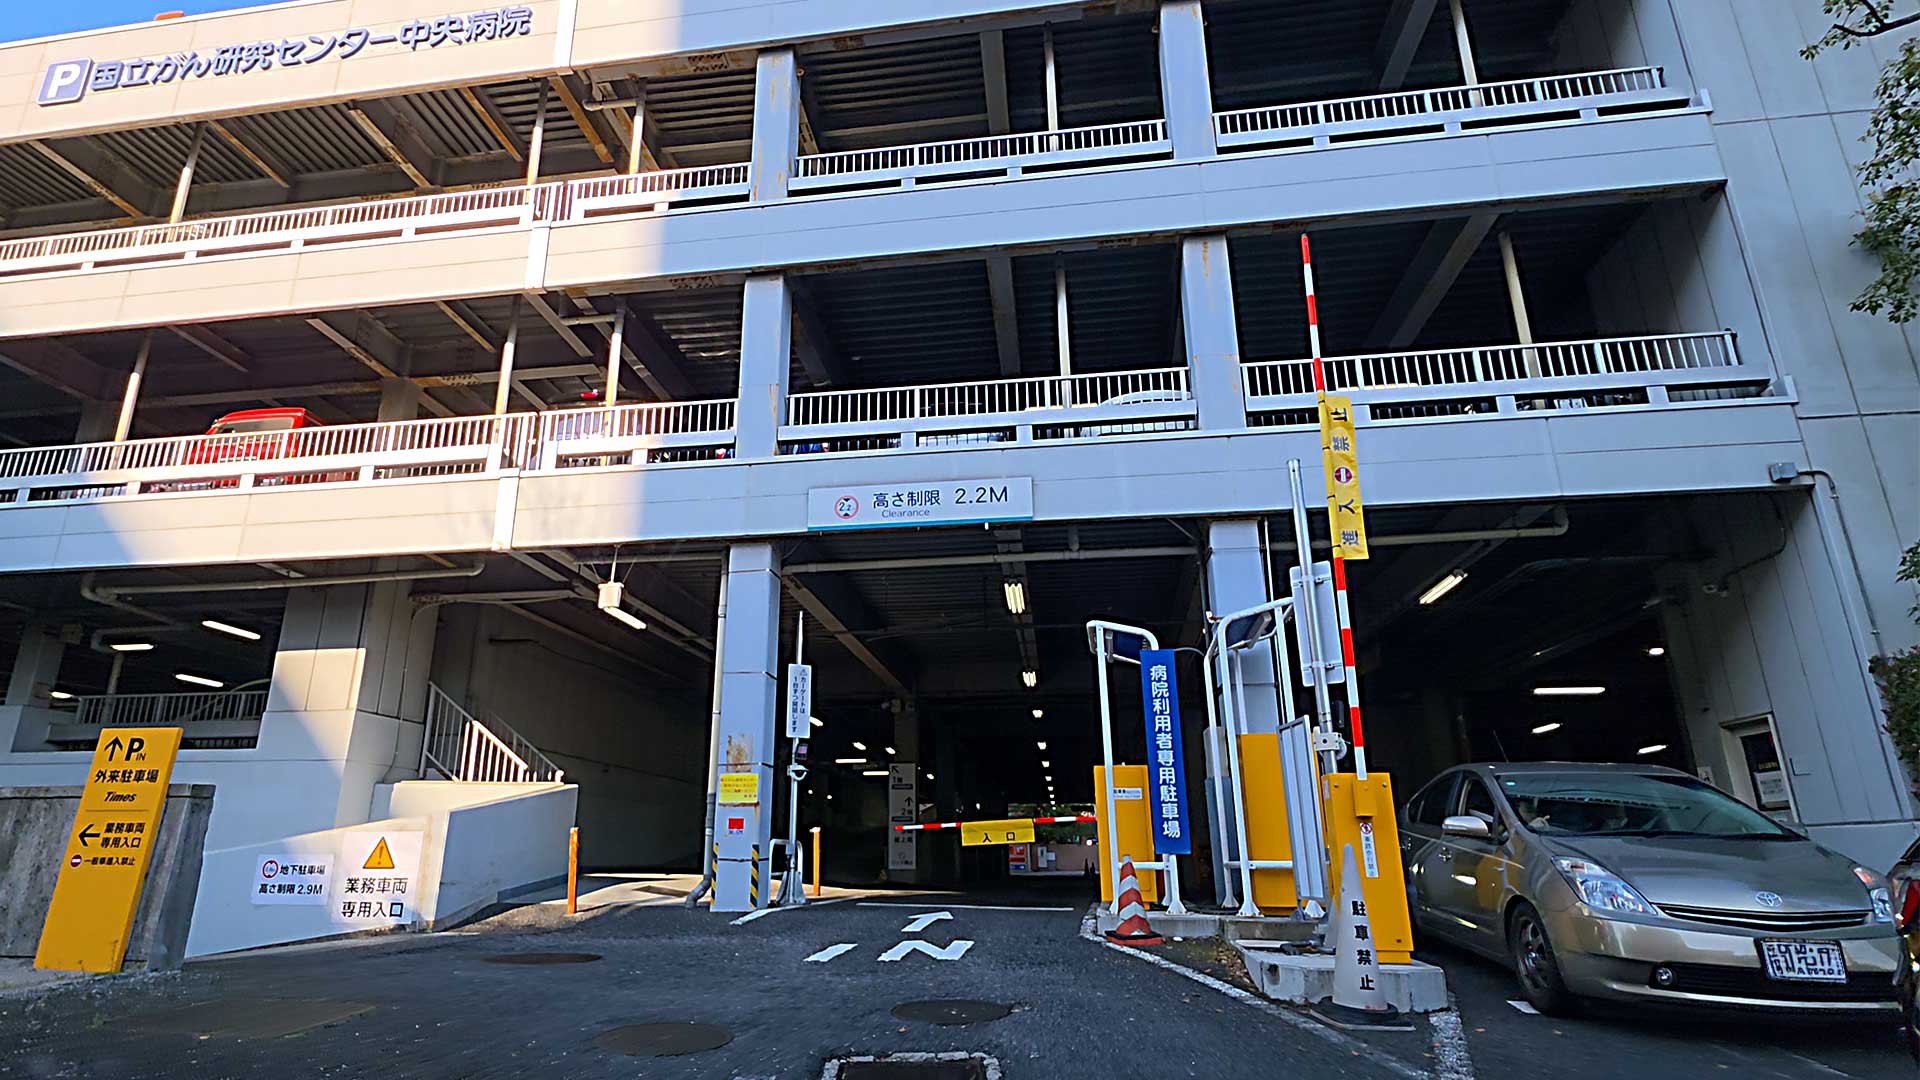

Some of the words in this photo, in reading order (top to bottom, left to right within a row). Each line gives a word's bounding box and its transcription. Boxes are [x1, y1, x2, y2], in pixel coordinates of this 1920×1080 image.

[47, 64, 78, 98] P
[91, 5, 533, 92] 国立がん研究センター中央病院
[873, 489, 941, 509] 高さ制限
[954, 486, 1009, 505] 2.2M
[881, 508, 931, 519] Clearance
[124, 738, 145, 761] P
[136, 753, 146, 761] IN
[1150, 664, 1181, 839] 病院利用者専用駐車場
[94, 769, 159, 783] 外来駐車場
[104, 791, 137, 802] Times
[104, 823, 145, 834] 業務車両
[101, 837, 142, 848] 専用入口
[982, 832, 1016, 843] 入口
[280, 864, 326, 876] 地下駐車場
[259, 883, 296, 894] 高さ制限
[297, 884, 323, 895] 2.9M
[344, 877, 409, 895] 業務車両
[341, 901, 404, 918] 専用入口
[1351, 900, 1376, 991] 駐車禁止
